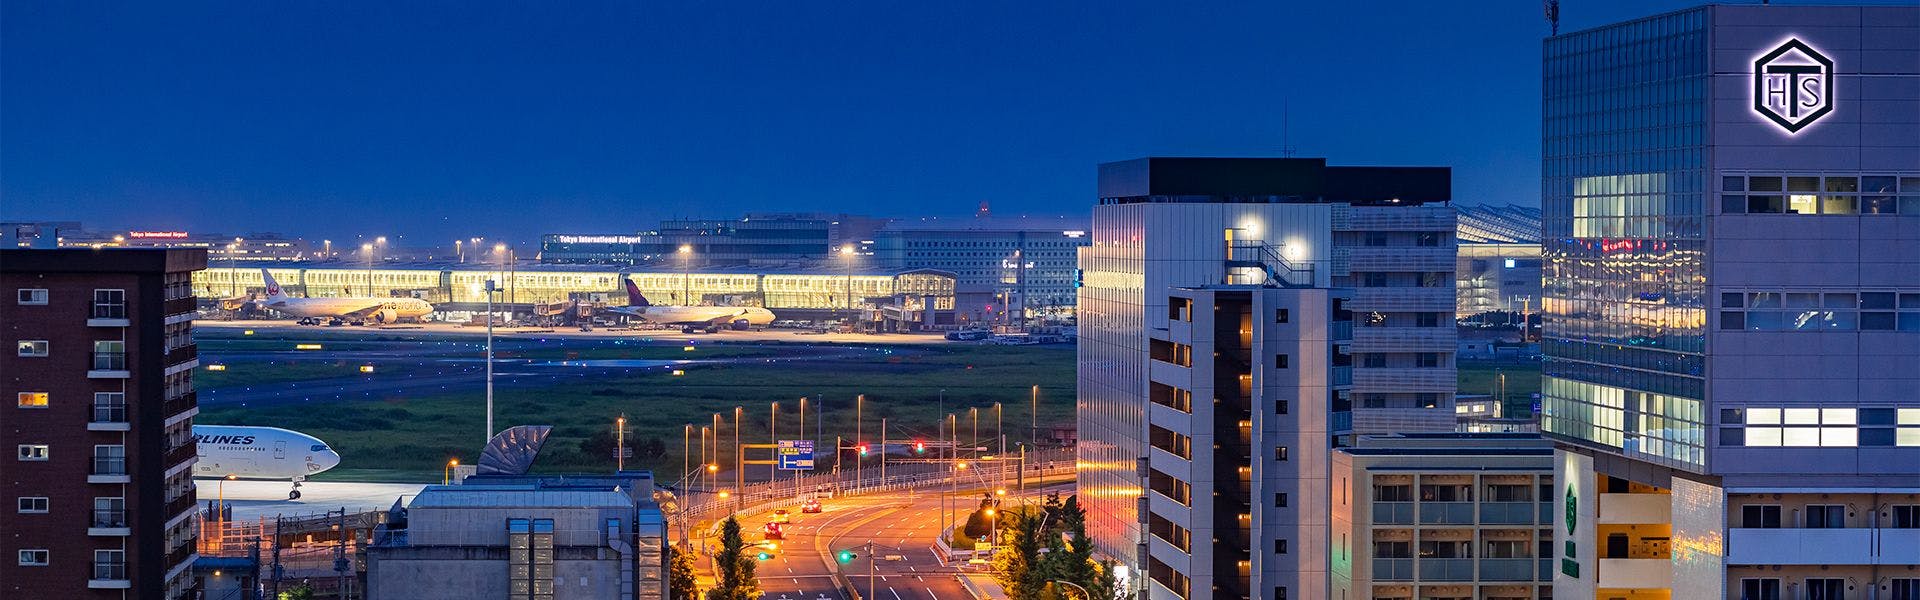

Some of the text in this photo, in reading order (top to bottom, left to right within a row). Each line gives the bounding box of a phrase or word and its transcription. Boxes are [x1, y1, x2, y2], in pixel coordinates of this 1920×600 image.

[559, 235, 641, 244] Tokyo International Airport
